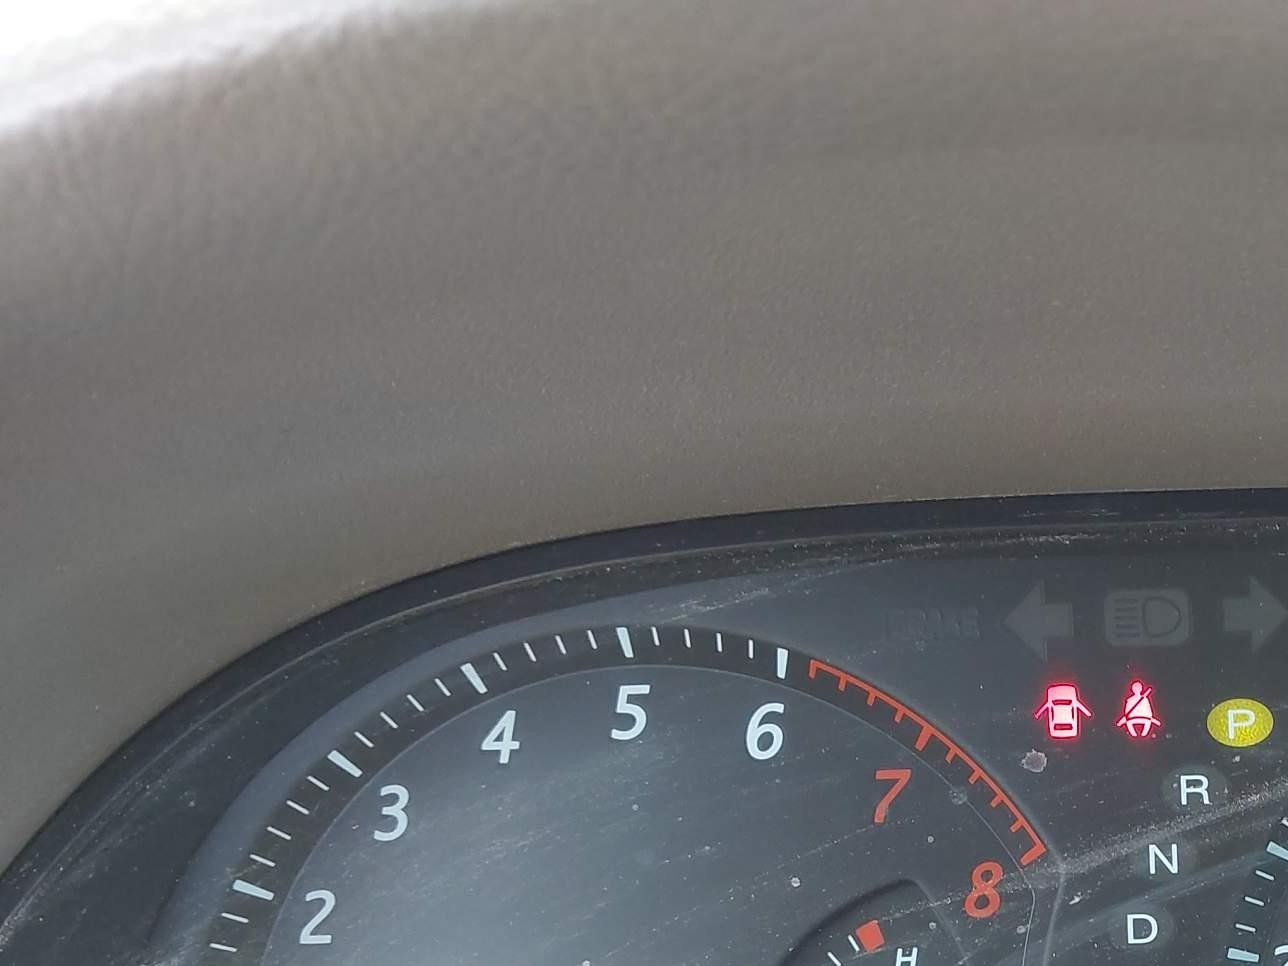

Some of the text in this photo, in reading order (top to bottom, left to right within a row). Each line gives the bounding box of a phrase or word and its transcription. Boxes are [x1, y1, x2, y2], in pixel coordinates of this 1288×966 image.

[481, 710, 520, 763] 4
[611, 684, 651, 740] 5
[745, 702, 785, 760] 6
[1227, 709, 1256, 739] P
[374, 784, 410, 841] 3
[873, 768, 912, 823] 7
[1180, 775, 1210, 805] R
[1148, 843, 1179, 874] N
[963, 861, 1003, 918] 8
[299, 890, 336, 944] 2
[1126, 914, 1158, 944] D
